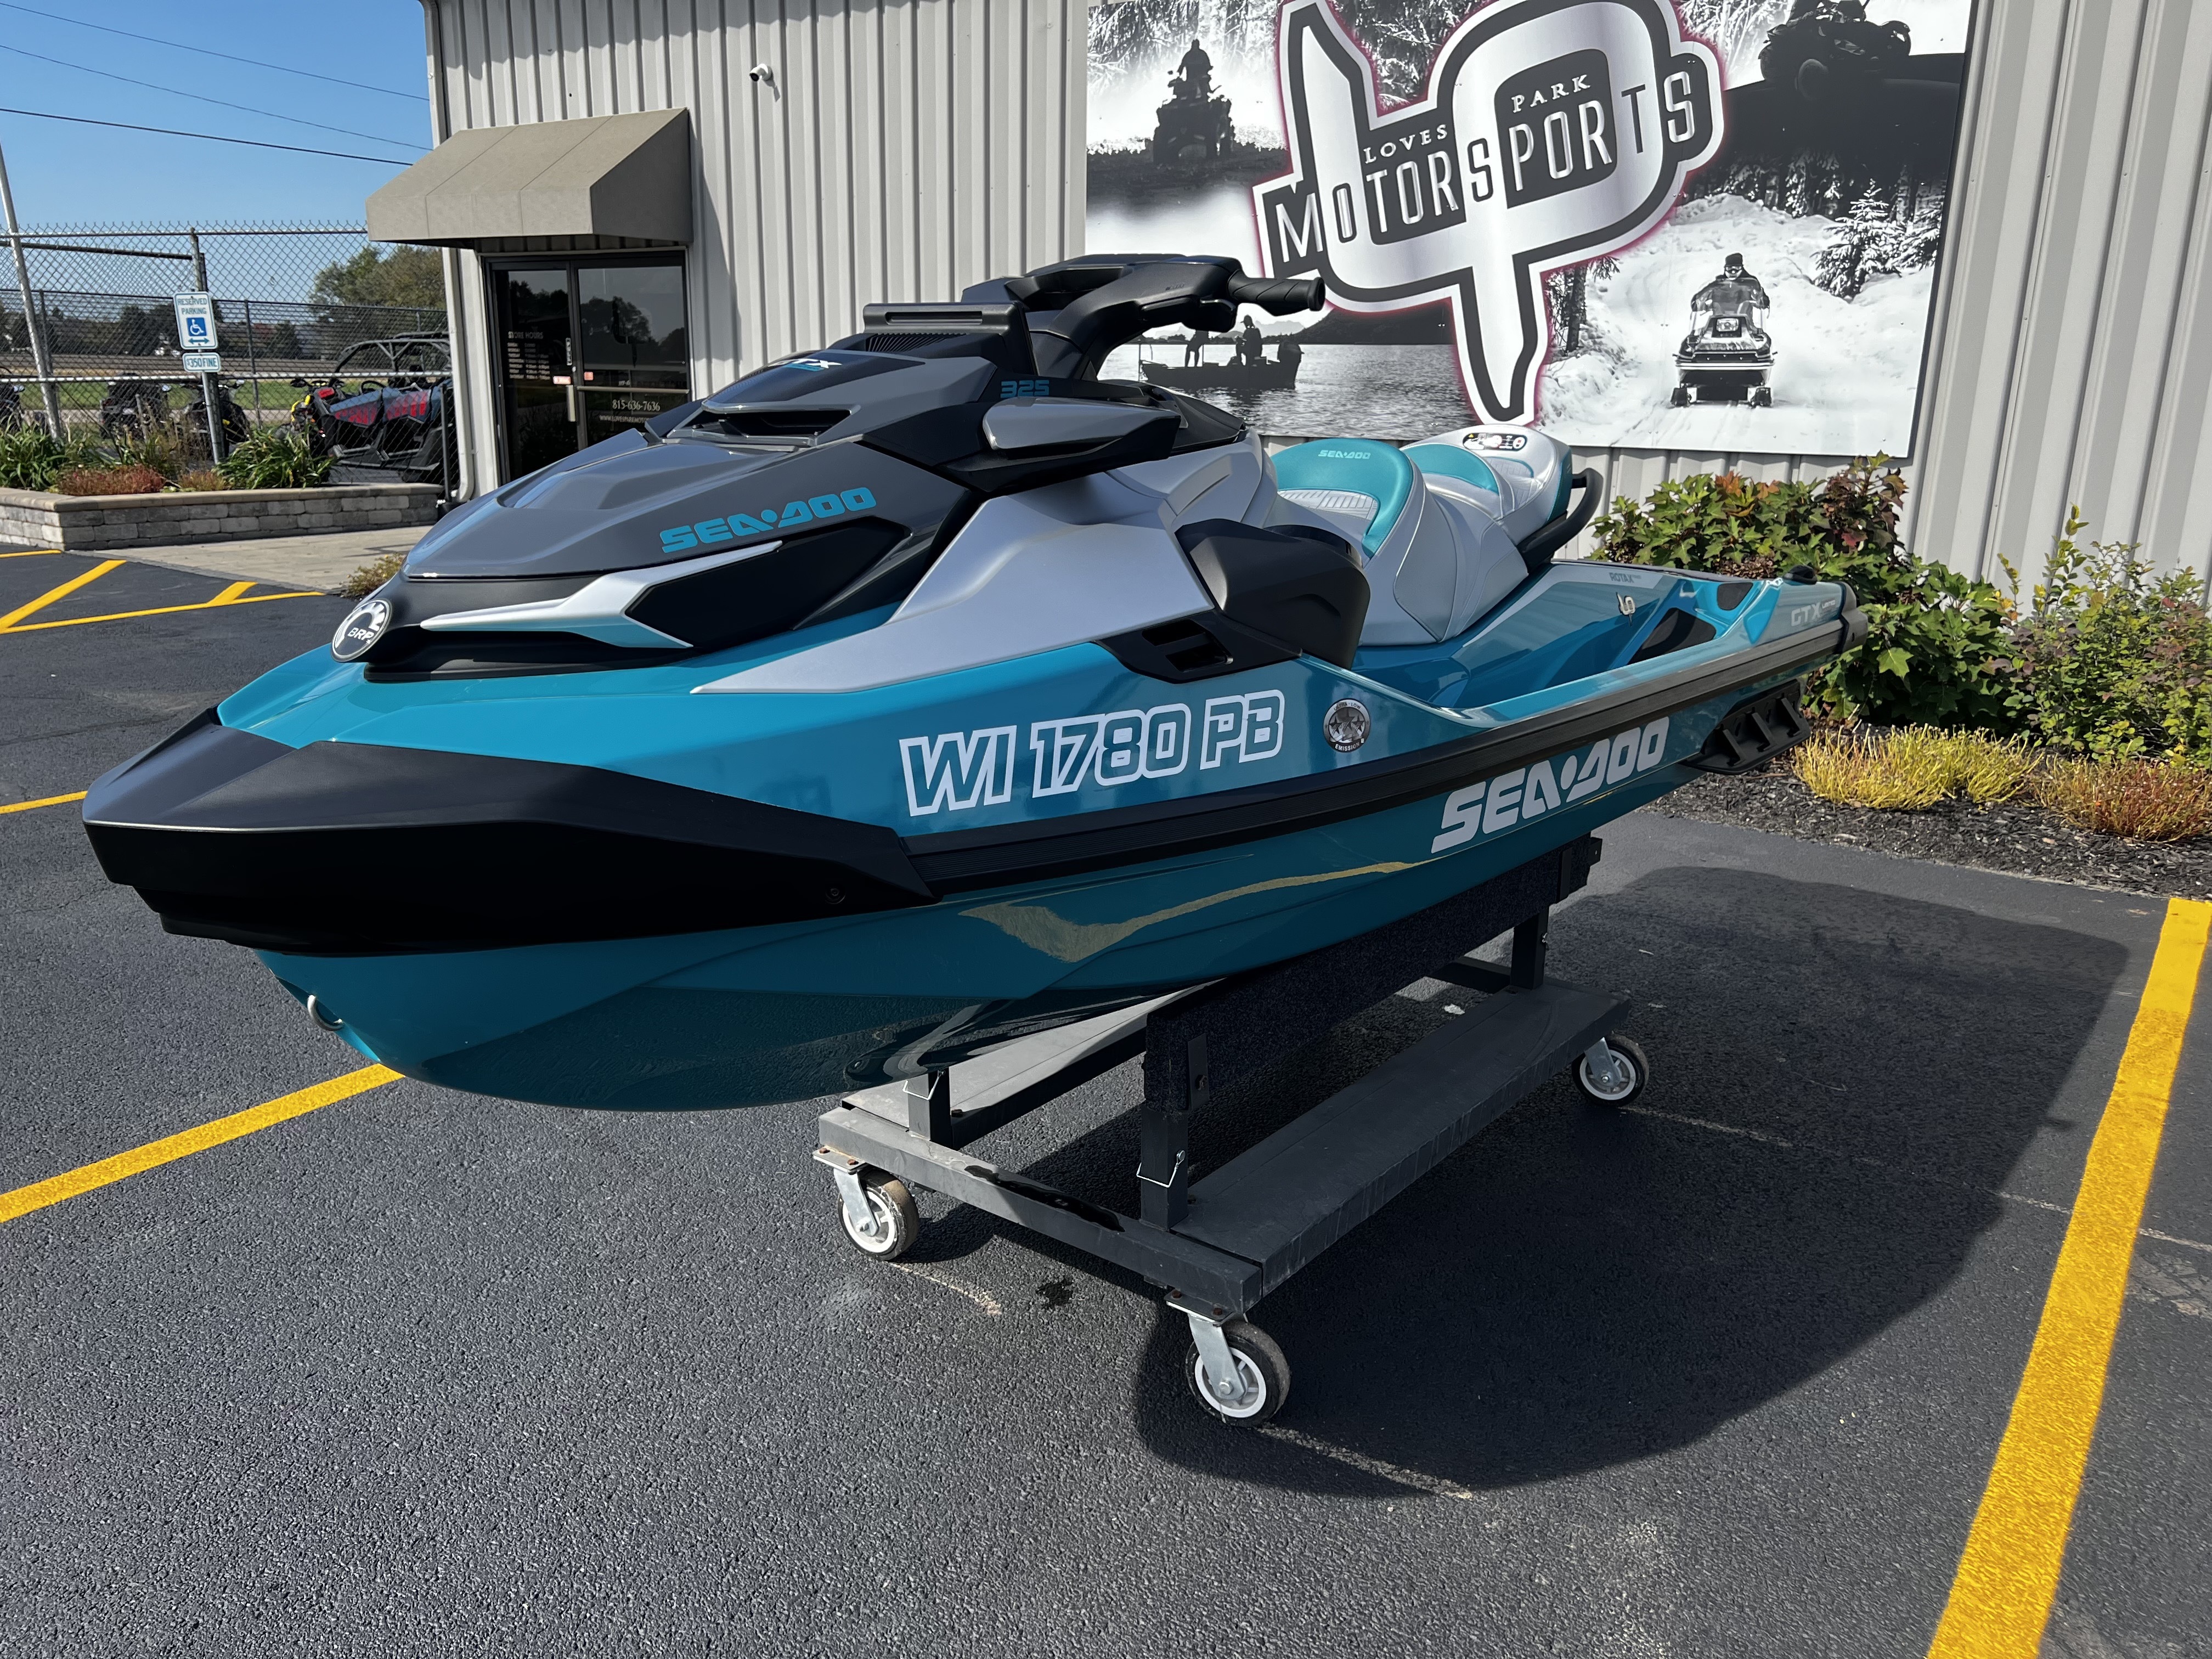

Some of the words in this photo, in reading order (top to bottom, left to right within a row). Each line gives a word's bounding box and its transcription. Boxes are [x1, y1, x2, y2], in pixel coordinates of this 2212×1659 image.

[1363, 124, 1448, 164] LOVES
[1511, 74, 1591, 114] PARK
[1274, 71, 1696, 264] MOTORSPORTS
[202, 357, 218, 367] FINE
[1000, 380, 1049, 398] 325
[612, 399, 661, 411] 815-636-7636
[1609, 572, 1634, 583] ROTAX
[1791, 602, 1821, 626] GTX
[347, 627, 374, 640] BRP
[899, 724, 1017, 816] WI
[1030, 703, 1192, 798] 1780
[1200, 689, 1285, 770] PB
[1335, 742, 1360, 752] EMISSION
